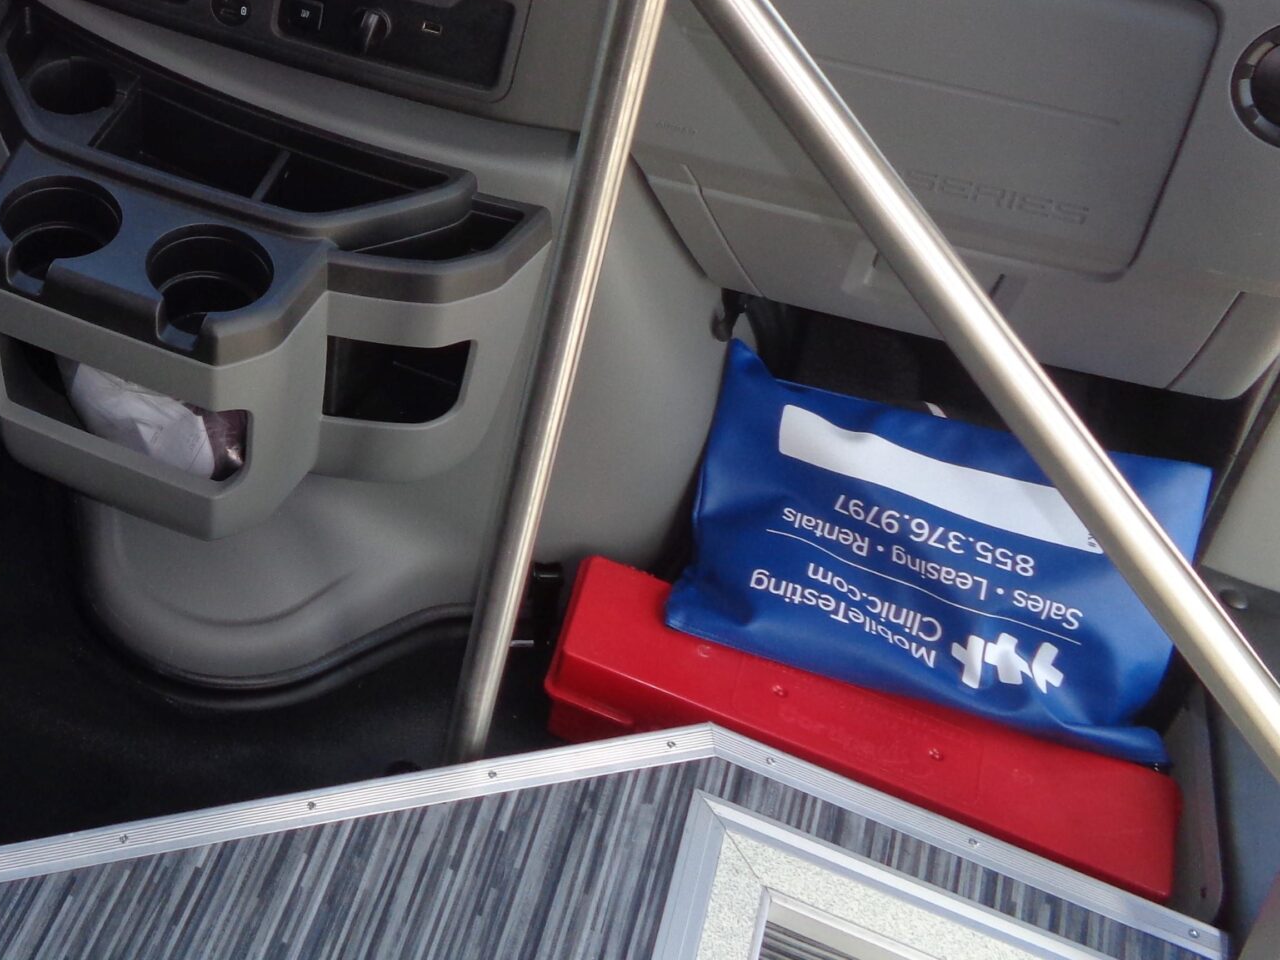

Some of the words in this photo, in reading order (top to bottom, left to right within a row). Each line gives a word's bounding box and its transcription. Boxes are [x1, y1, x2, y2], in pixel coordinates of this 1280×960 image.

[903, 168, 1090, 225] SERIES
[782, 506, 870, 557] Rentals
[833, 493, 1036, 577] 855.376.9797
[891, 545, 988, 601] Leasing
[749, 568, 937, 669] MobileTesting
[807, 562, 942, 642] Clinic.com
[1012, 589, 1084, 631] Sales
